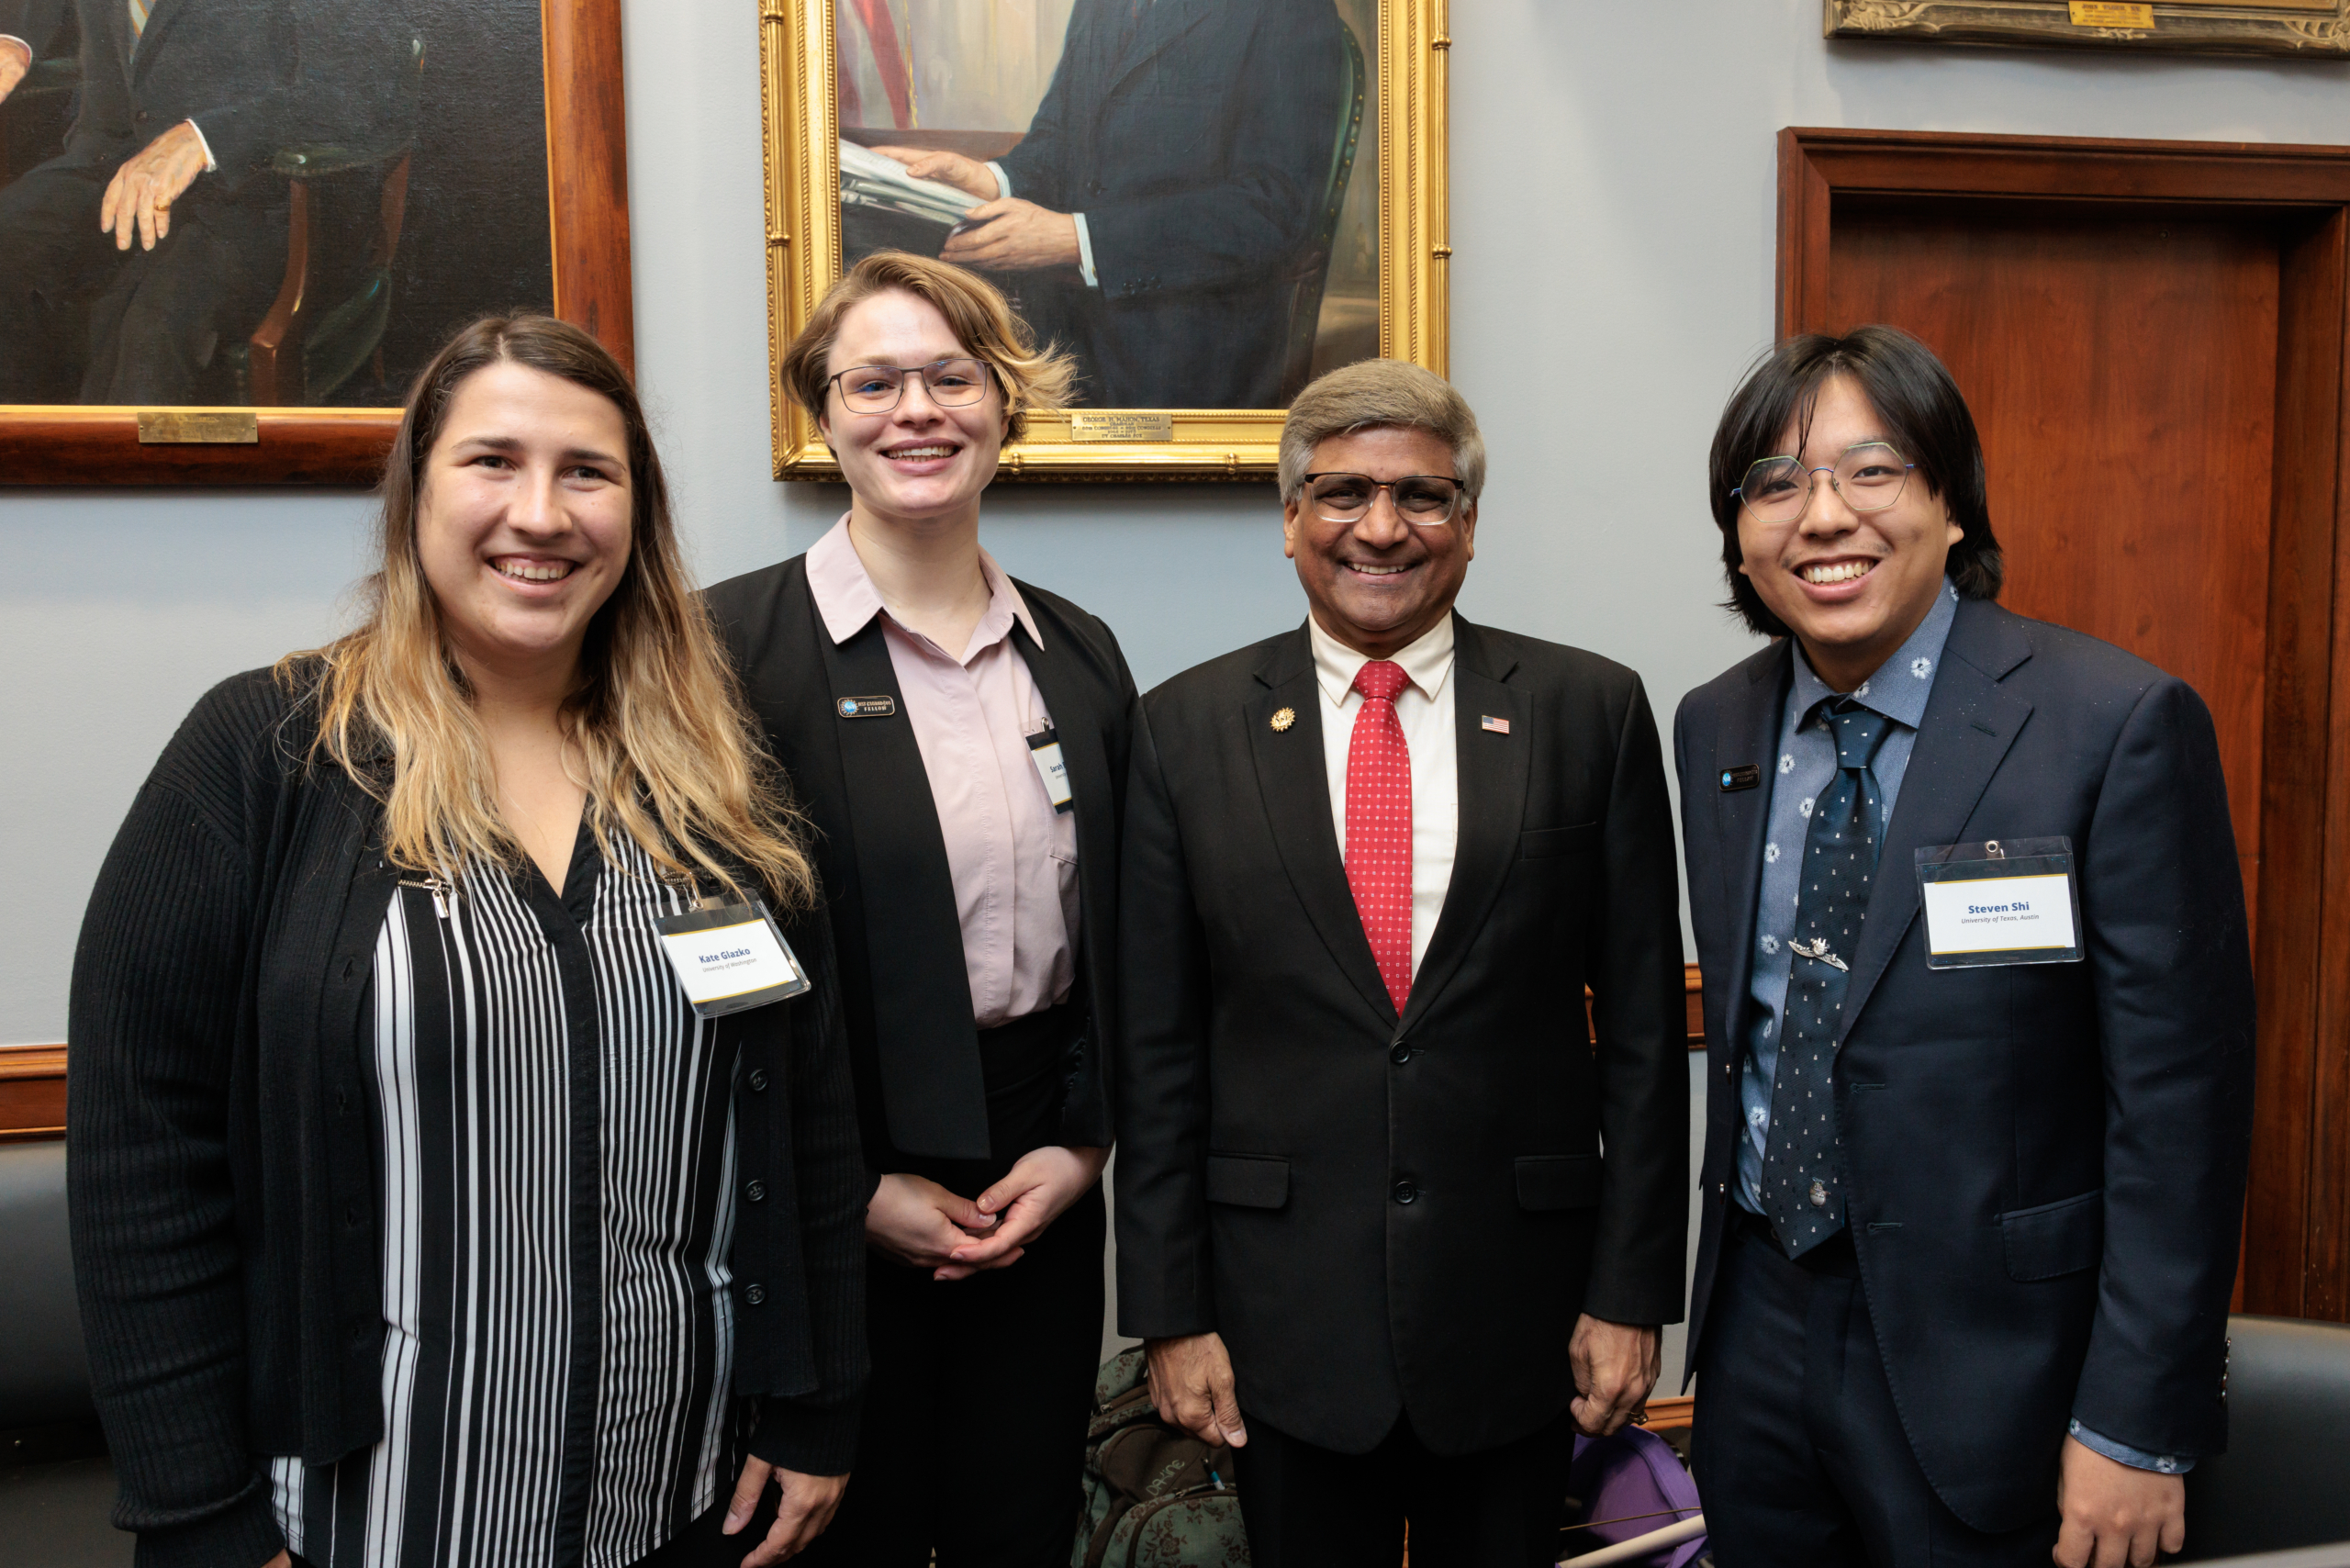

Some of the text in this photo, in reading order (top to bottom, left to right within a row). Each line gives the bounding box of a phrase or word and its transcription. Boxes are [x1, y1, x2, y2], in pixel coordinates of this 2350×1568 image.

[1050, 763, 1063, 773] Sarah
[1968, 902, 2030, 914] Steven Shi
[1961, 916, 1991, 924] University
[1992, 915, 2000, 924] of
[2000, 914, 2019, 923] Texas,
[699, 947, 751, 964] Kate Glazko
[702, 964, 724, 973] University
[731, 958, 757, 968] Washington
